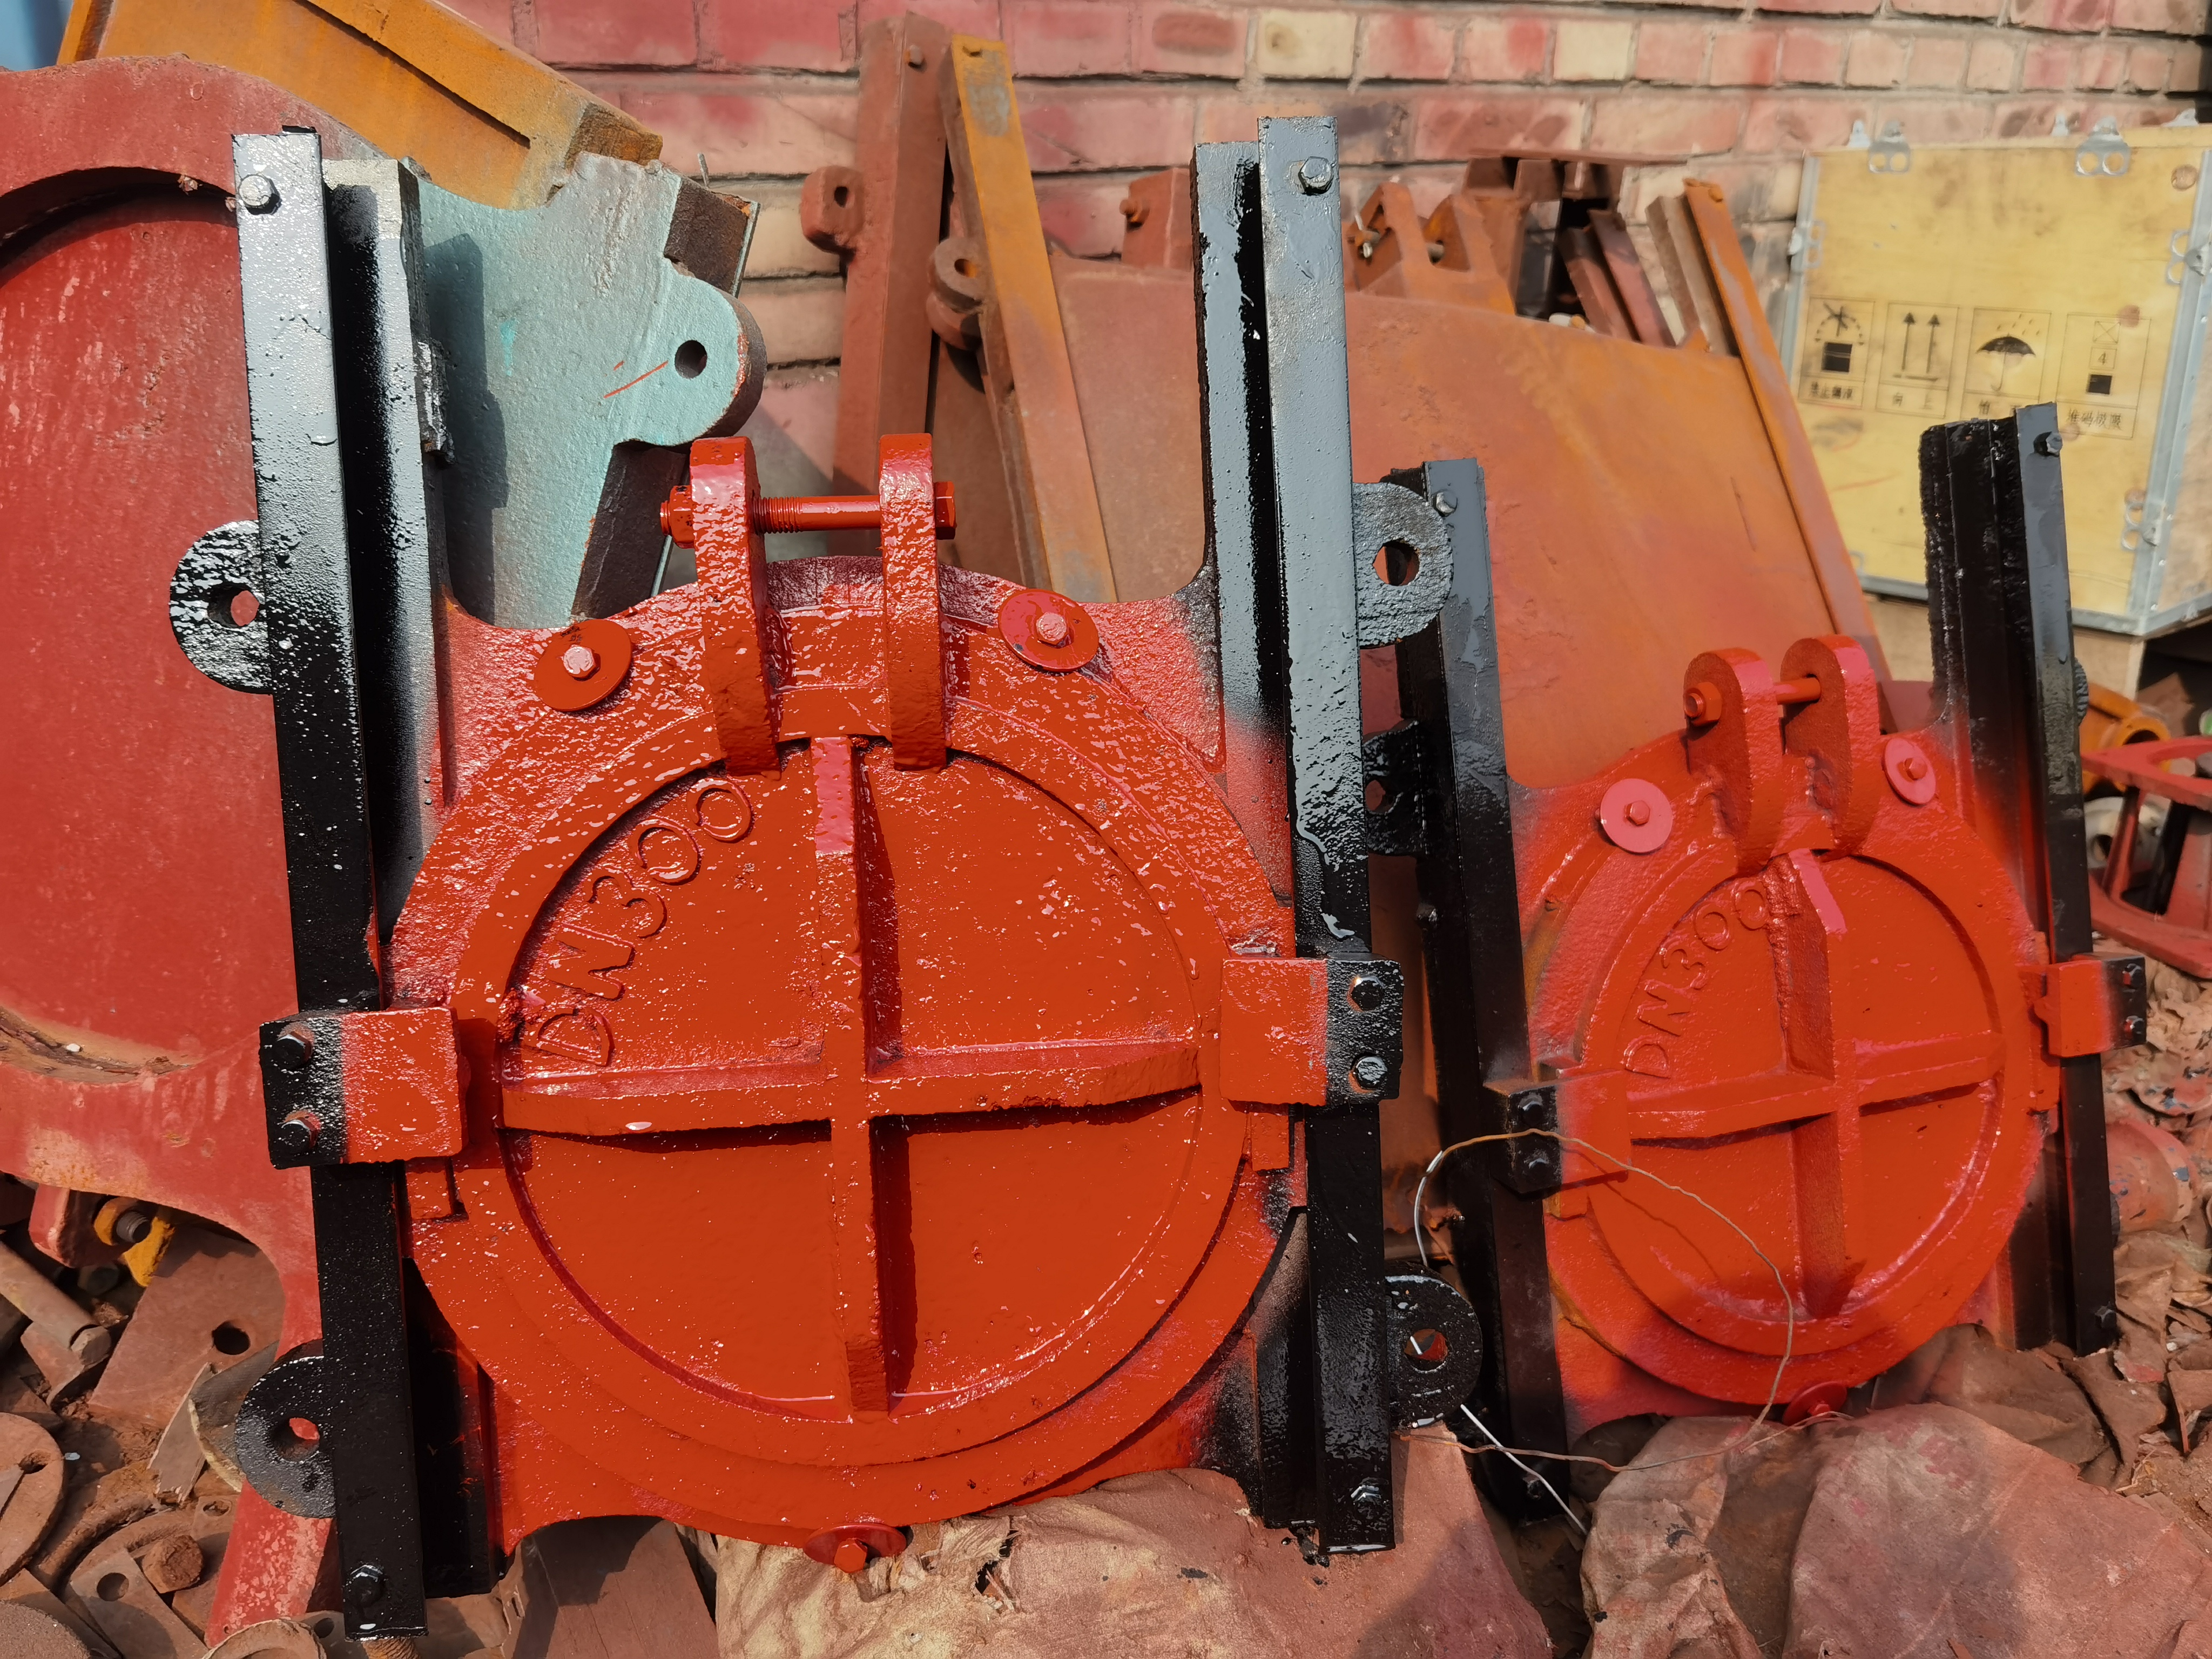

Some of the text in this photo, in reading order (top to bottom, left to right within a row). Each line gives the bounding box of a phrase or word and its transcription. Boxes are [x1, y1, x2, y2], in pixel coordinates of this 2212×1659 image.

[2098, 352, 2107, 366] 4
[522, 777, 756, 1068] DN300
[1623, 879, 1770, 1080] DN300
